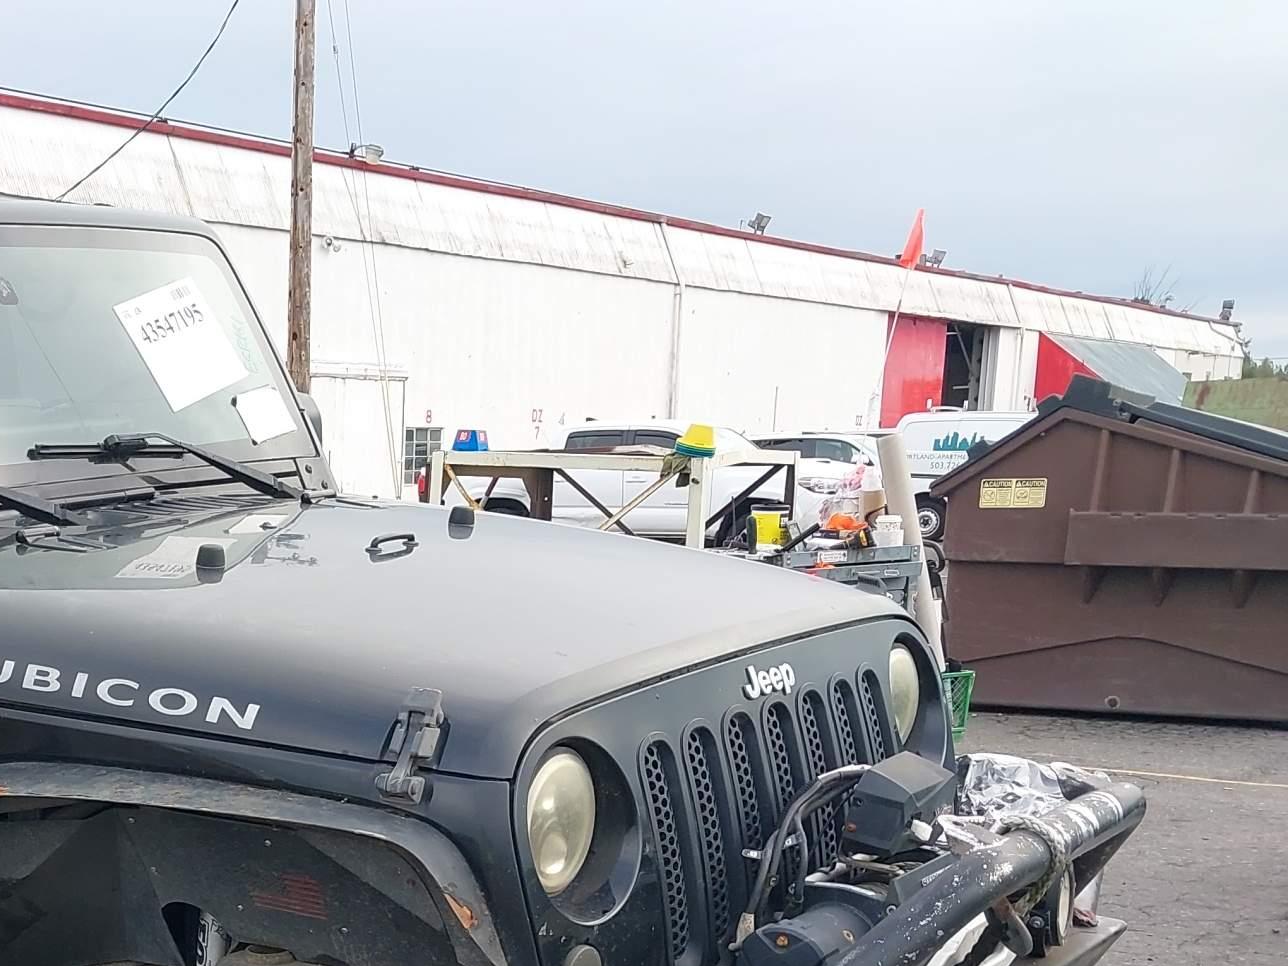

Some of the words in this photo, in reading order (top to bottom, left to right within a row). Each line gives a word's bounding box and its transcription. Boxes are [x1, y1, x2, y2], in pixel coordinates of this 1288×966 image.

[140, 303, 204, 344] 43547195
[426, 409, 432, 424] 8
[743, 663, 795, 699] Jeep
